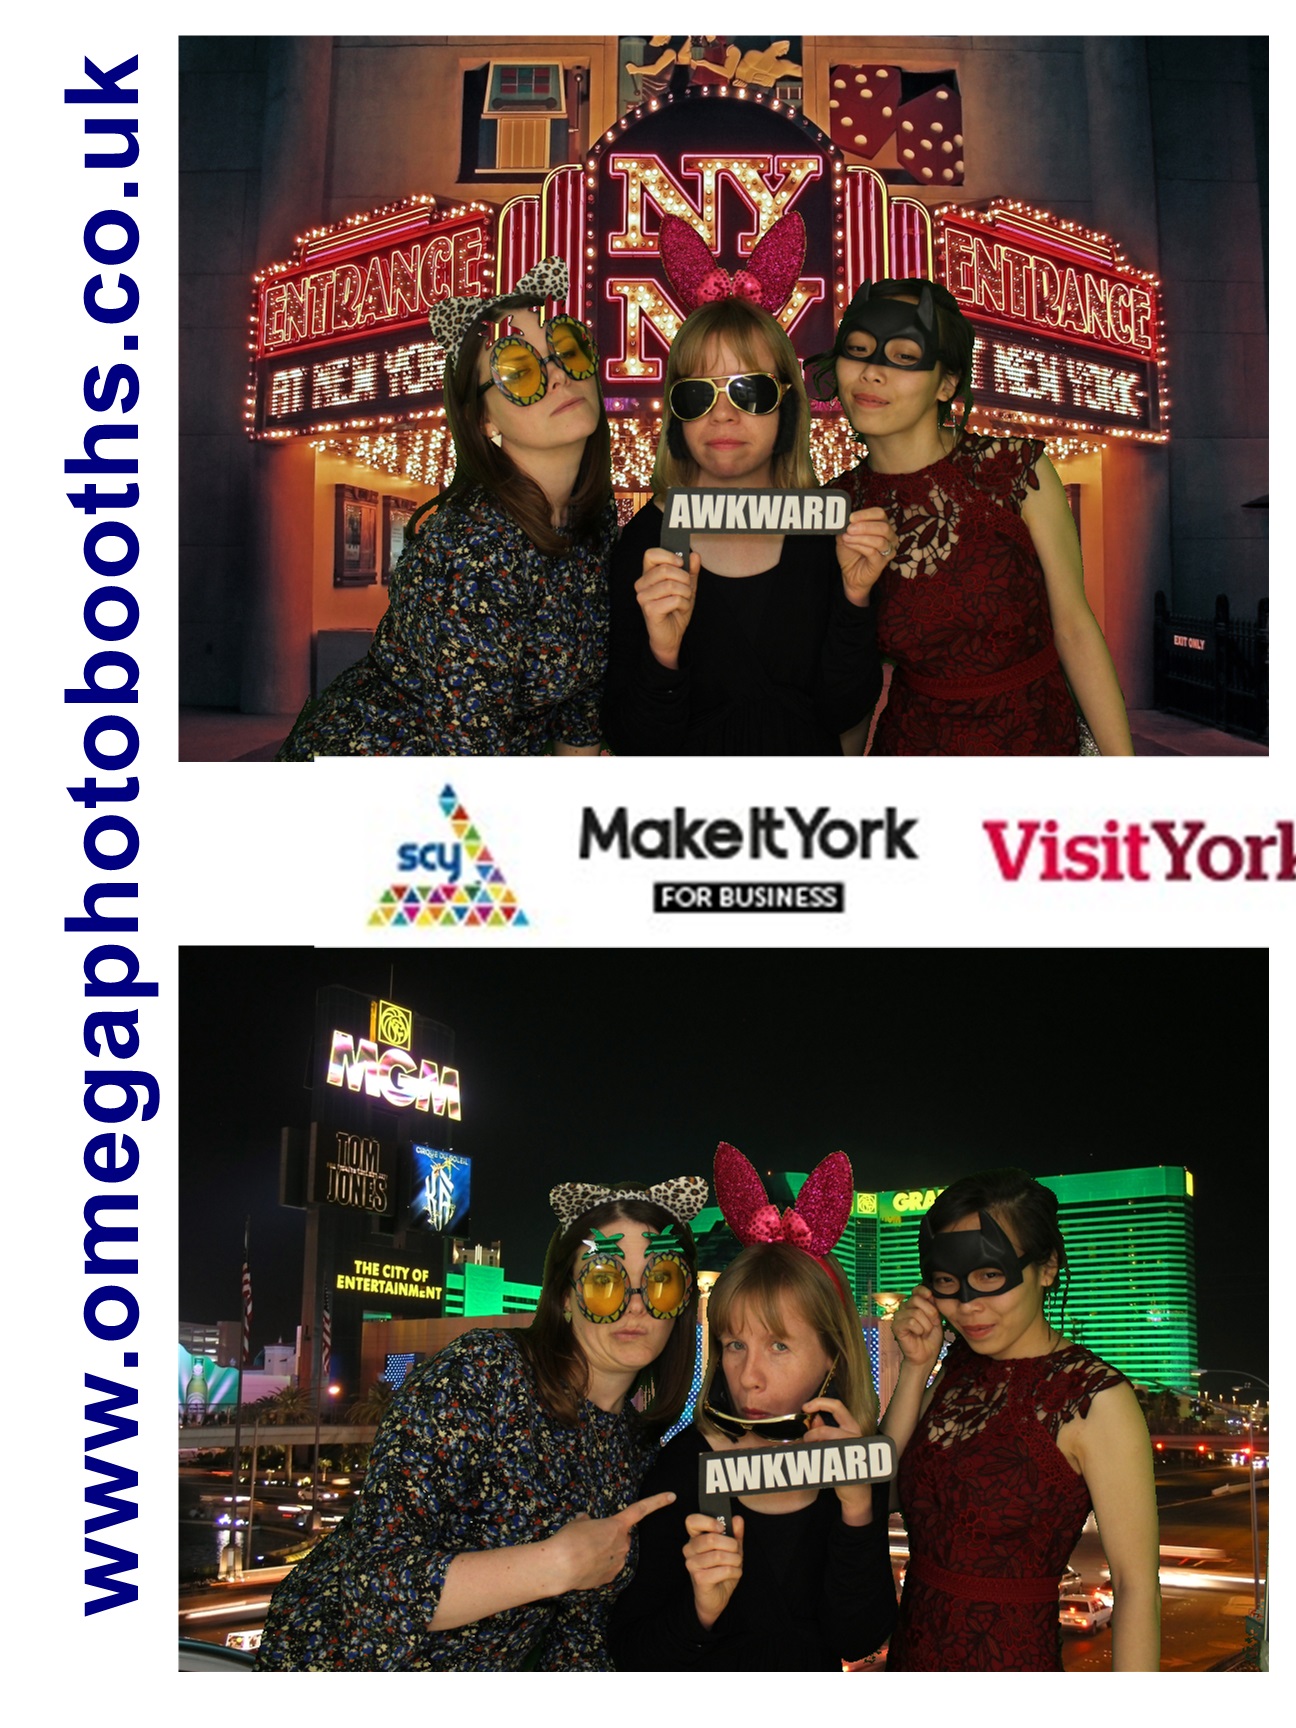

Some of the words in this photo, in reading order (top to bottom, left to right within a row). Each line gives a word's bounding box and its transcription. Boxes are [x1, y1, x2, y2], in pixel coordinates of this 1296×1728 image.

[608, 154, 823, 256] NY
[264, 226, 485, 347] ENTRANCE
[943, 227, 1153, 352] ENTRANCE
[312, 352, 379, 409] NEW
[668, 494, 847, 530] AWKWARD
[1173, 634, 1188, 647] EXIT
[1188, 637, 1206, 651] ONLY
[326, 1029, 462, 1122] MGM
[336, 1131, 381, 1174] TOM
[415, 1146, 439, 1159] CIRQUE
[449, 1155, 469, 1166] SOLEIL
[326, 1168, 388, 1213] JONES
[892, 1189, 945, 1212] GRA
[336, 1274, 443, 1300] ENTERTAINMENT
[354, 1260, 380, 1277] THE
[382, 1264, 410, 1280] CITY
[412, 1269, 429, 1283] OF
[705, 1441, 893, 1495] AWKWARD
